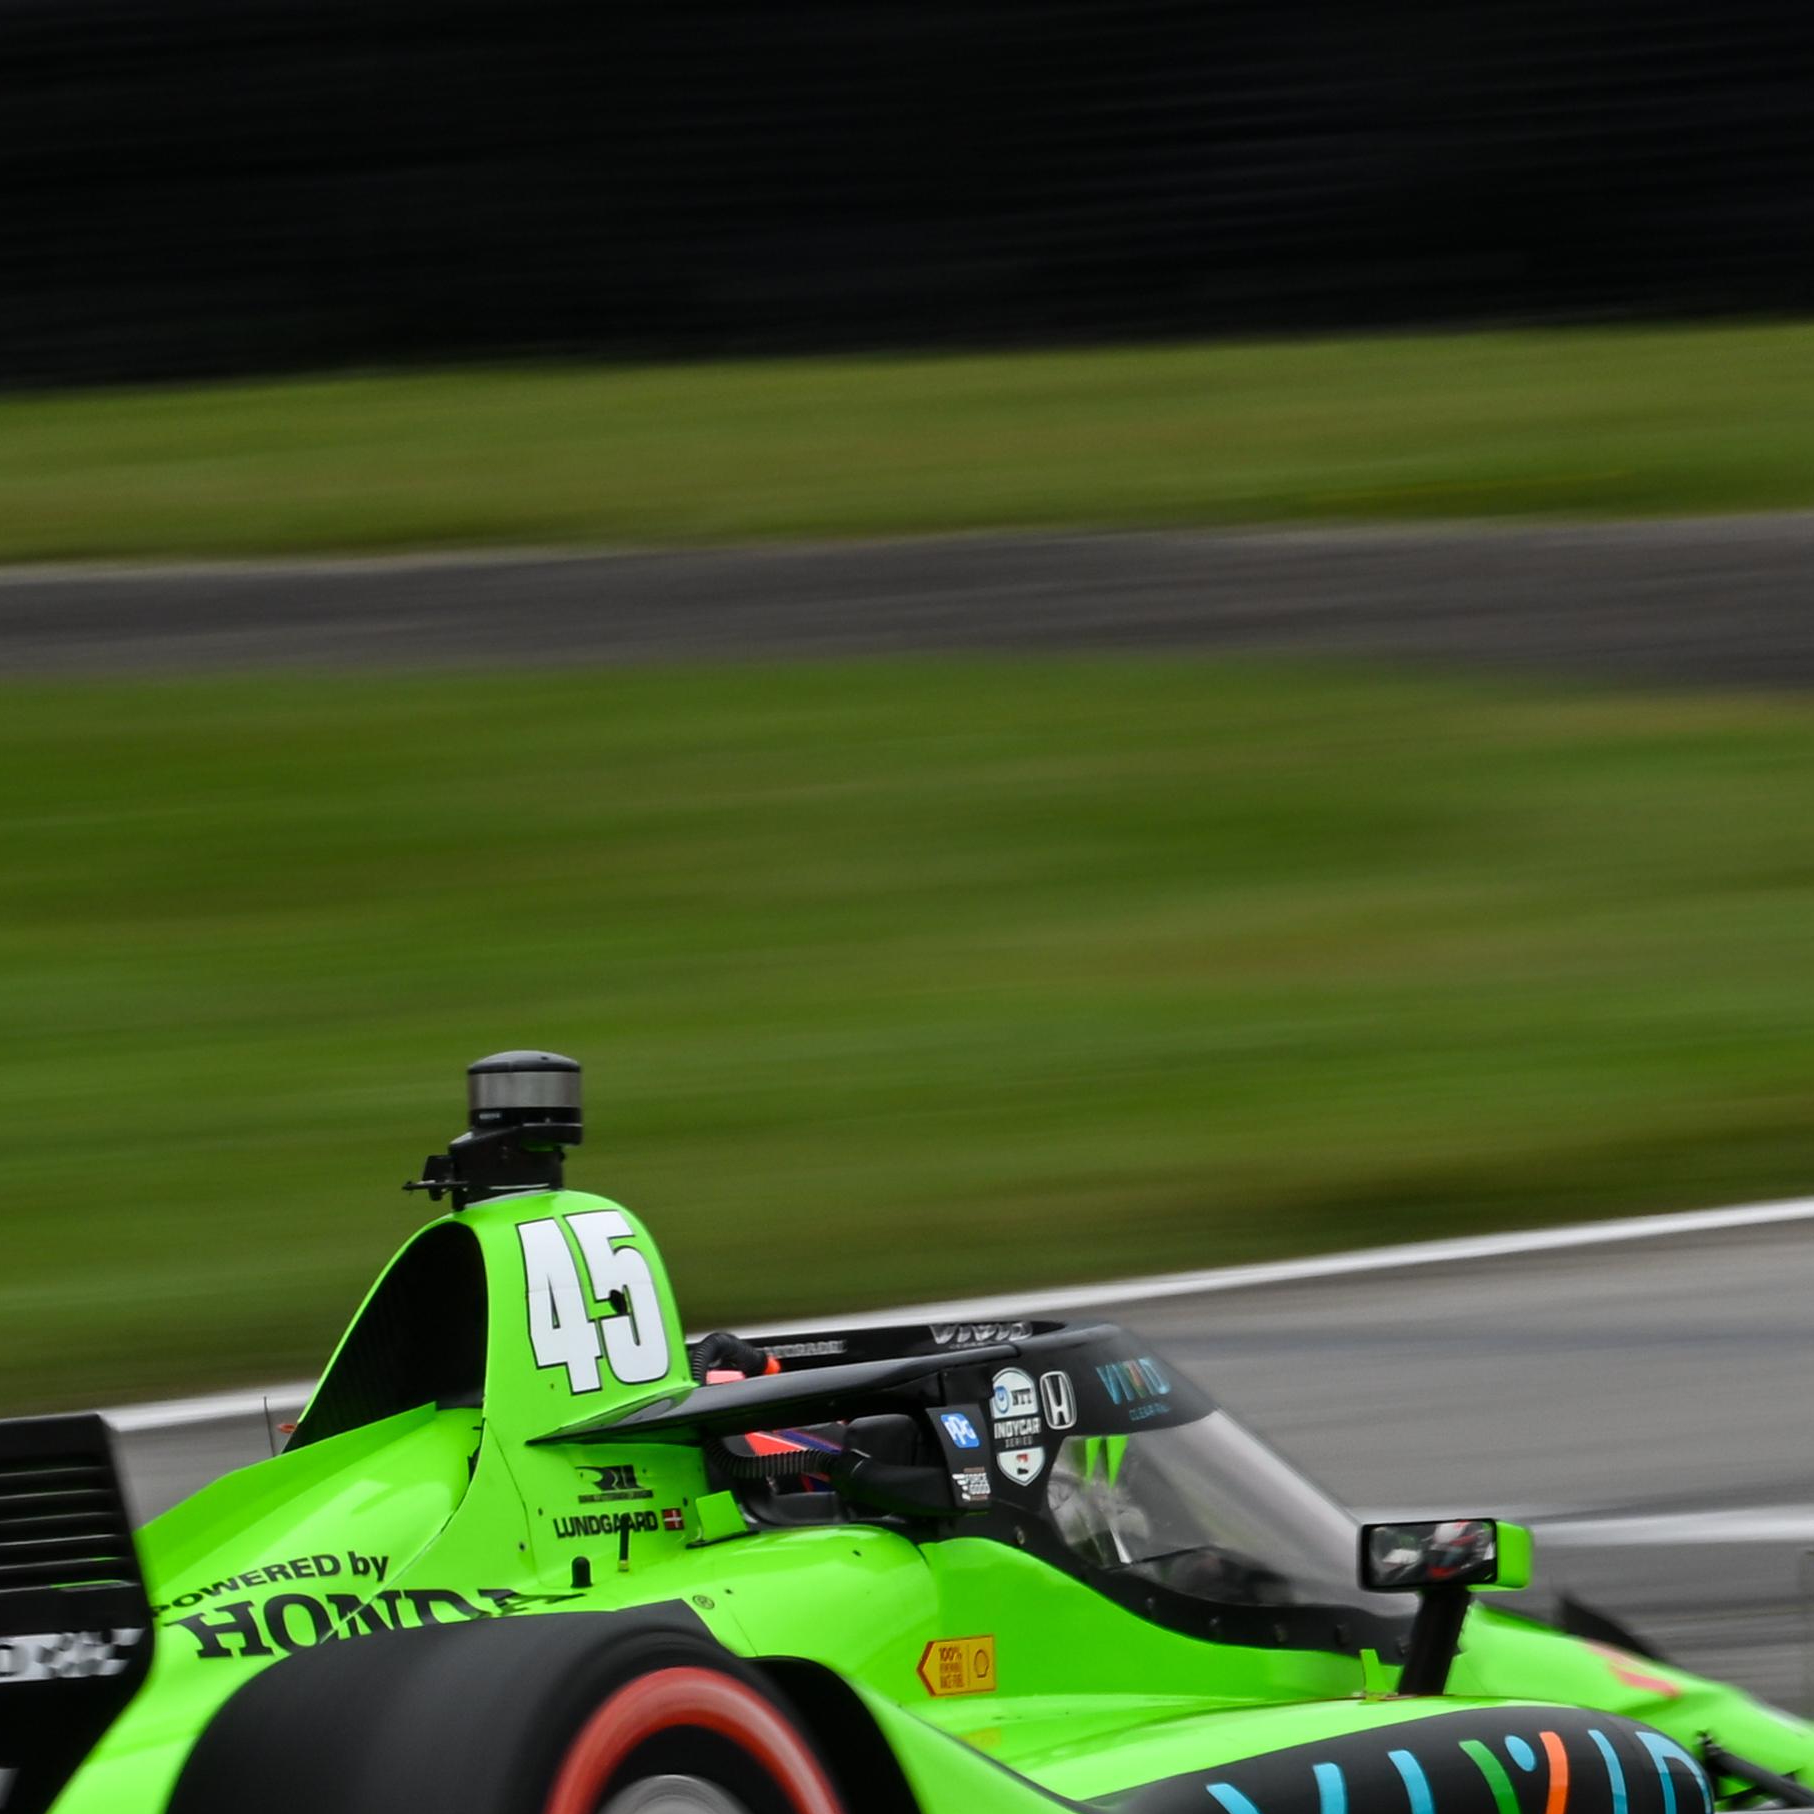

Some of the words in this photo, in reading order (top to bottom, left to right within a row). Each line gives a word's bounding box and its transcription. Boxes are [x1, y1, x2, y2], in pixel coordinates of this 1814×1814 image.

[517, 1209, 670, 1395] 45
[942, 1416, 977, 1446] PPG
[994, 1417, 1042, 1439] INDYCAR
[553, 1510, 658, 1539] LUNDGAARD
[348, 1549, 390, 1582] by
